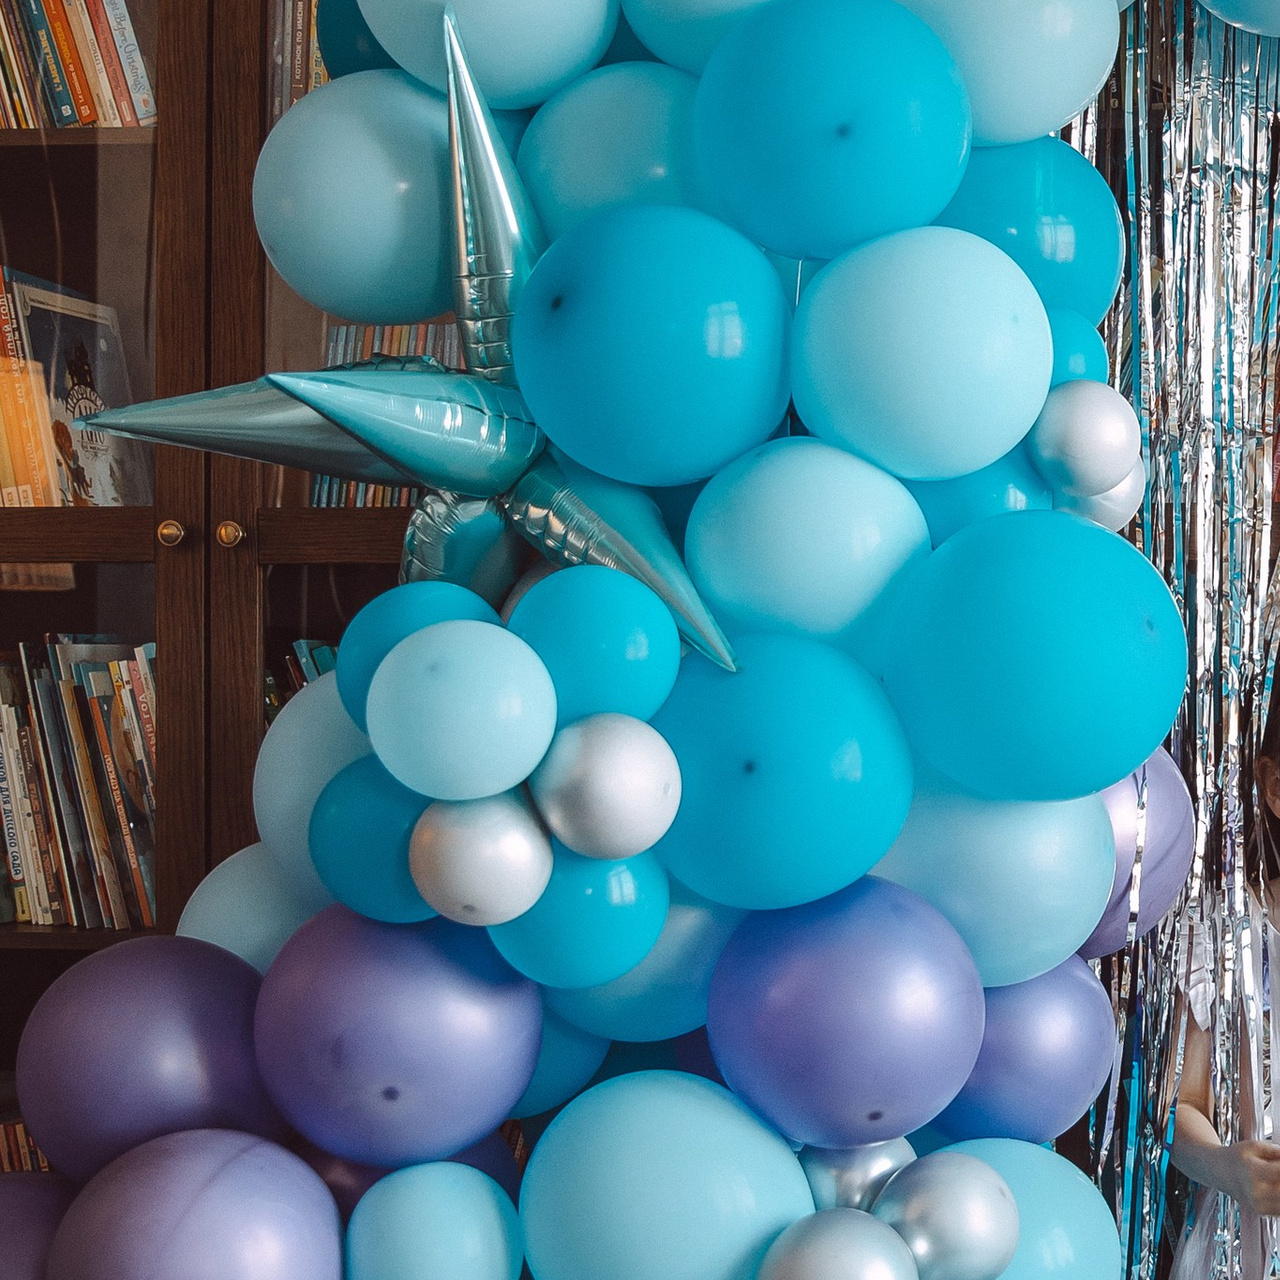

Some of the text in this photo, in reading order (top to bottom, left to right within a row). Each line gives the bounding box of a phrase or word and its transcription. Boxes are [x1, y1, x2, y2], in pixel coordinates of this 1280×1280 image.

[109, 11, 132, 46] Before
[295, 0, 304, 29] ИМЕНИ
[295, 30, 303, 42] ПО
[36, 27, 63, 93] L'AMBULANCE
[118, 41, 148, 95] Christmas
[294, 43, 303, 80] КОТЕНОК
[136, 691, 151, 720] ГОД
[2, 806, 17, 848] ДЕТСКОГО
[8, 849, 21, 876] САДА
